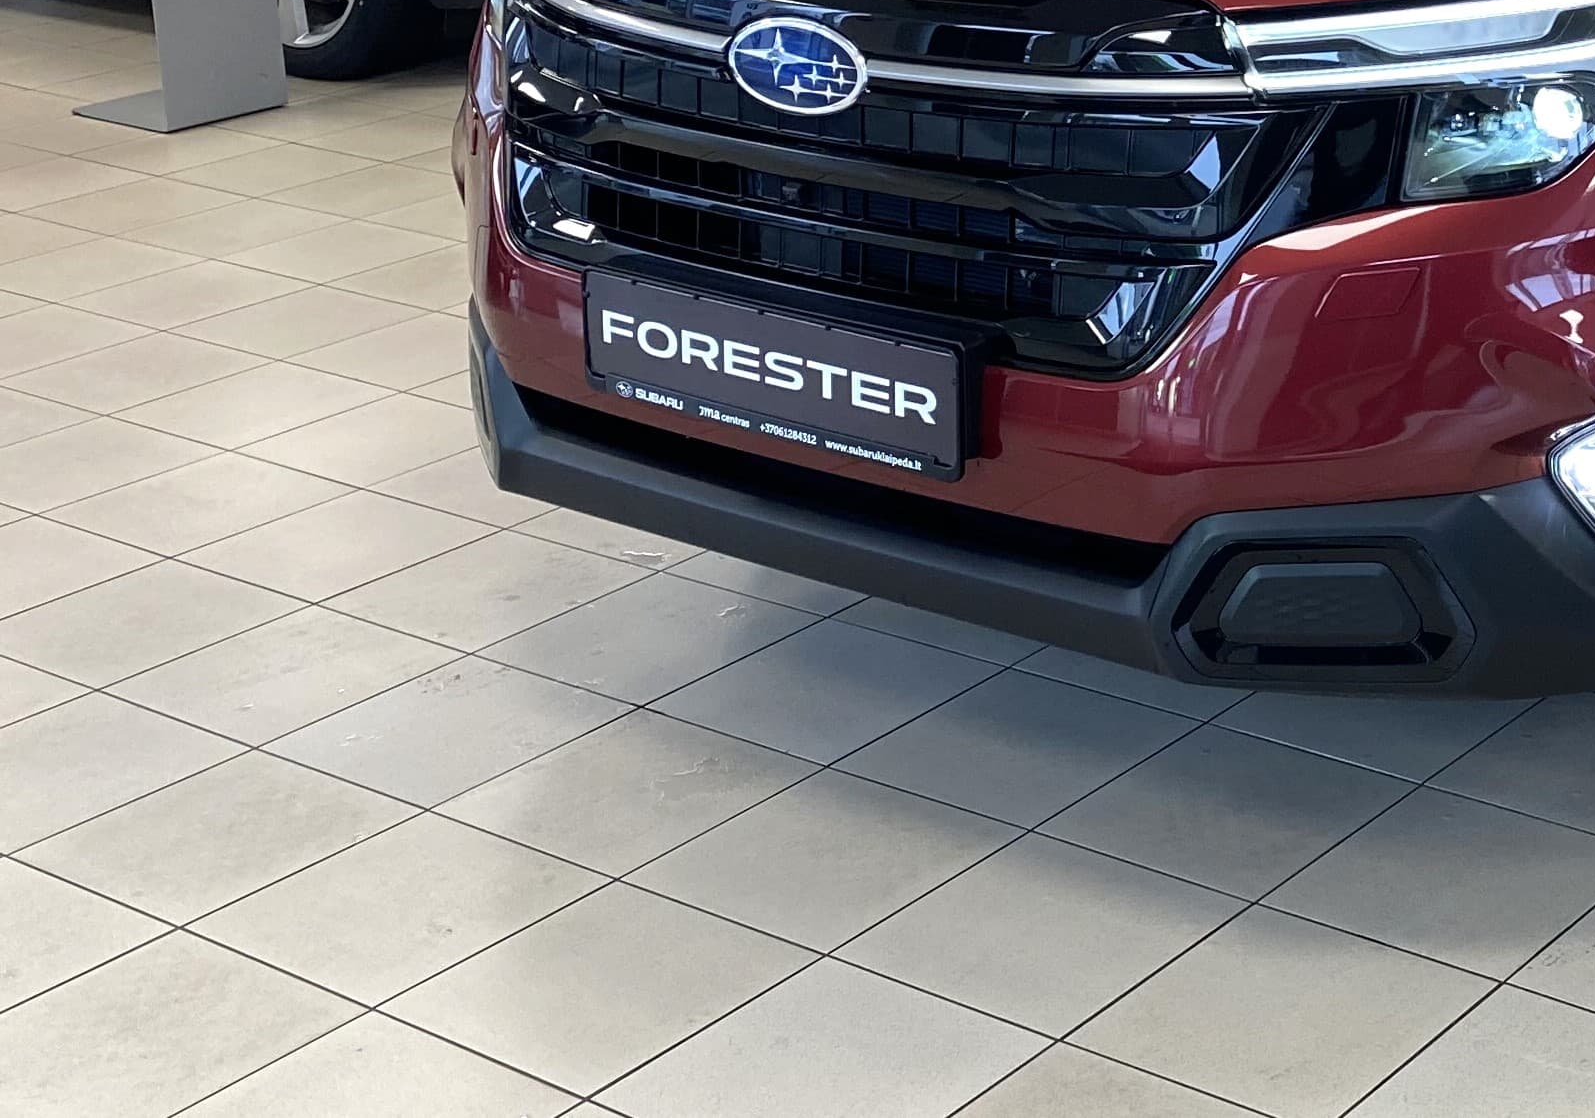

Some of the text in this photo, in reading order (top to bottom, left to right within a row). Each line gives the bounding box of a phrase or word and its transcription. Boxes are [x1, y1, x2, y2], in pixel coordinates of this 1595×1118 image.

[602, 309, 937, 425] FORESTER
[634, 387, 684, 411] SUBARU
[720, 413, 750, 428] centras
